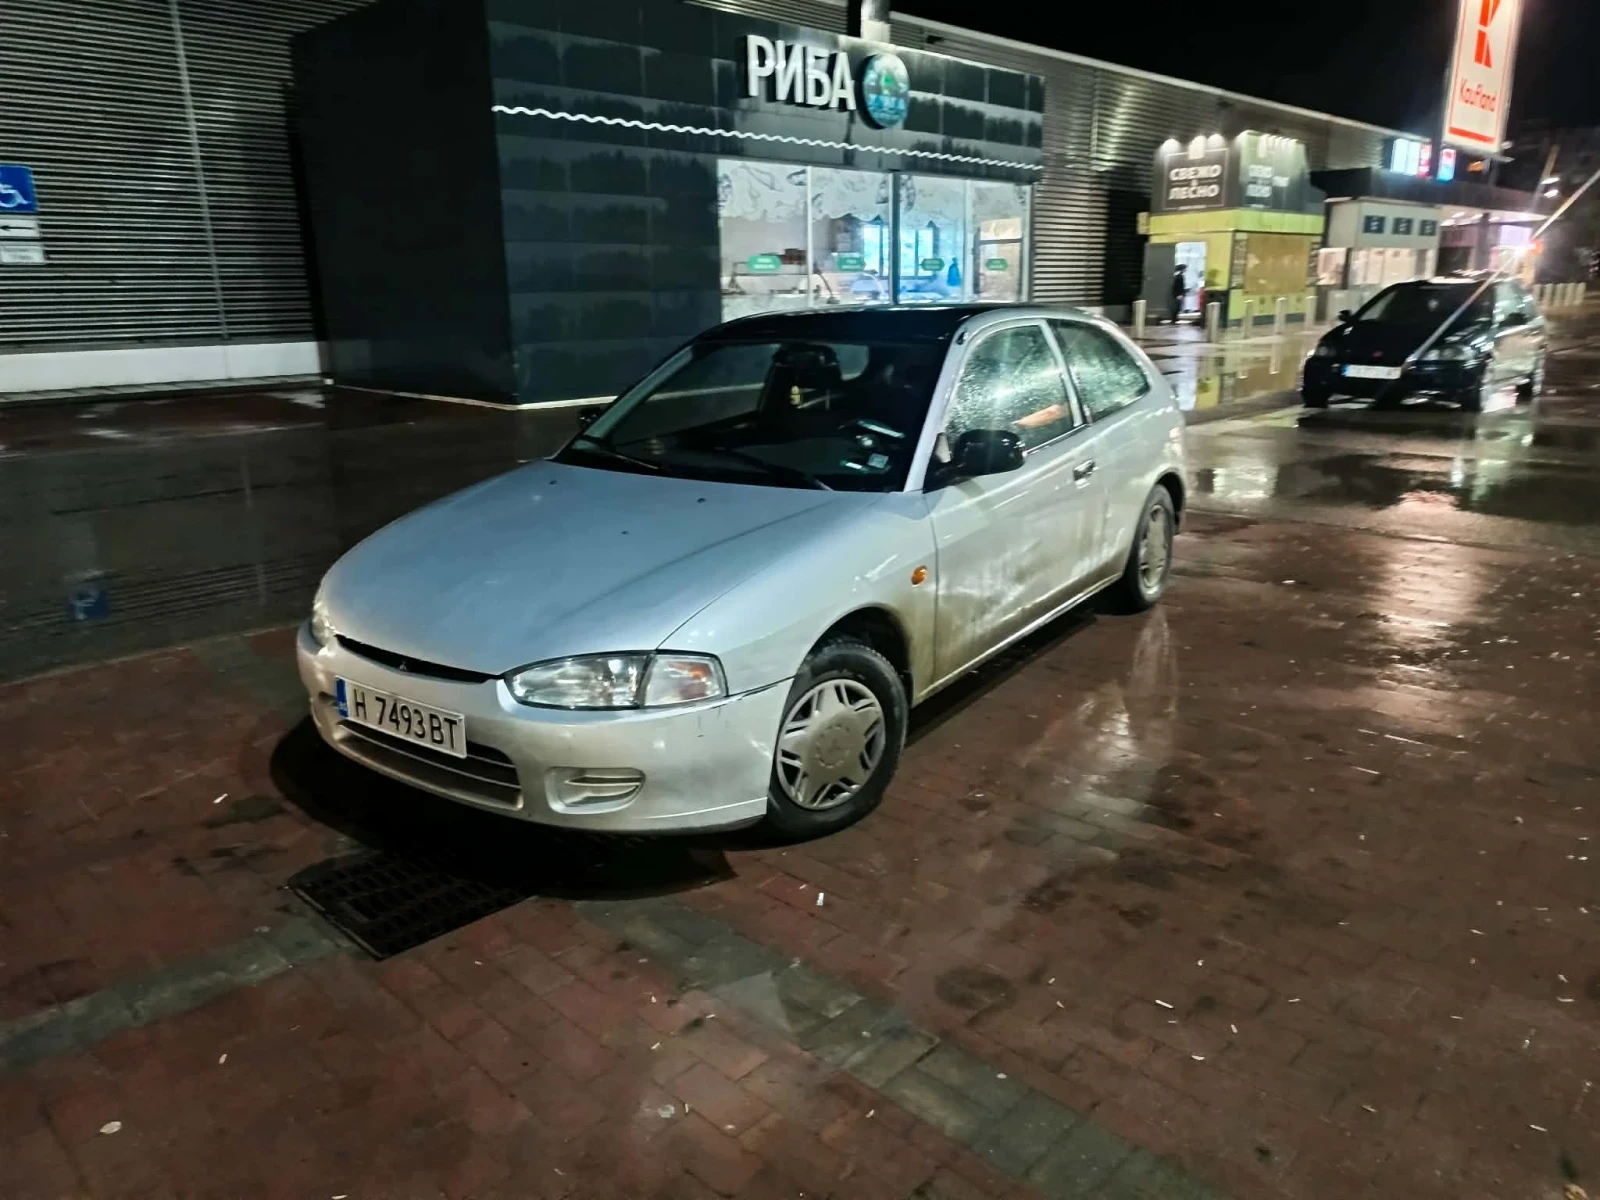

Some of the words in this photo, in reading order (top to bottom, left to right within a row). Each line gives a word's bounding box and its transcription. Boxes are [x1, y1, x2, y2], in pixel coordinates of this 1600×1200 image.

[747, 34, 857, 110] РИБА
[1460, 78, 1498, 112] Kaufland
[353, 688, 367, 720] H
